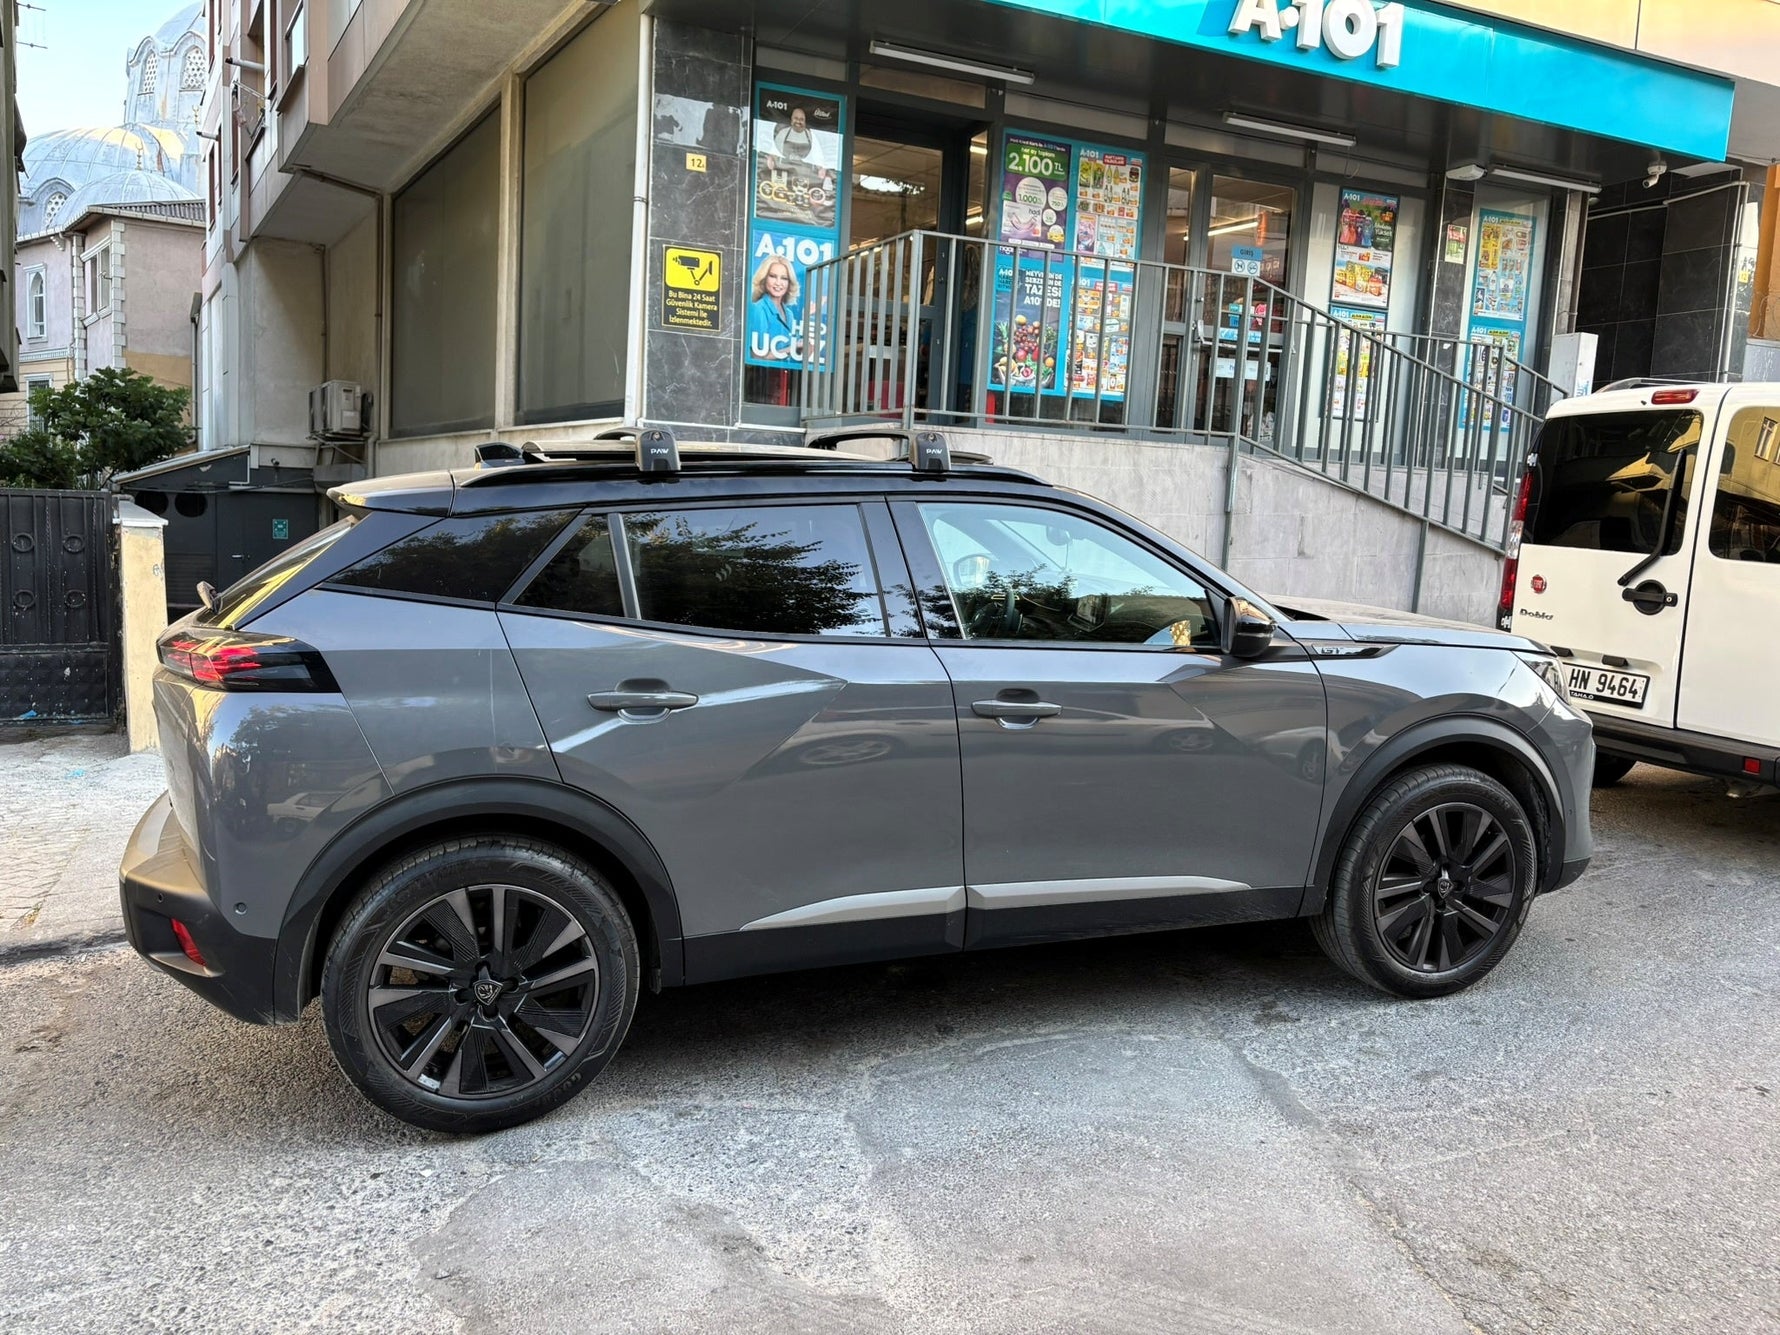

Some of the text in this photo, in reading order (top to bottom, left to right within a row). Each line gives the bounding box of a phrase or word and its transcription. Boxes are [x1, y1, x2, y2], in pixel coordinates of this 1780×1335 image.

[1008, 152, 1064, 176] 2.100 TL
[666, 298, 718, 311] Güvenlik Kamera
[692, 292, 701, 301] 24
[701, 294, 716, 302] Saat
[1568, 668, 1638, 699] HN 9464
